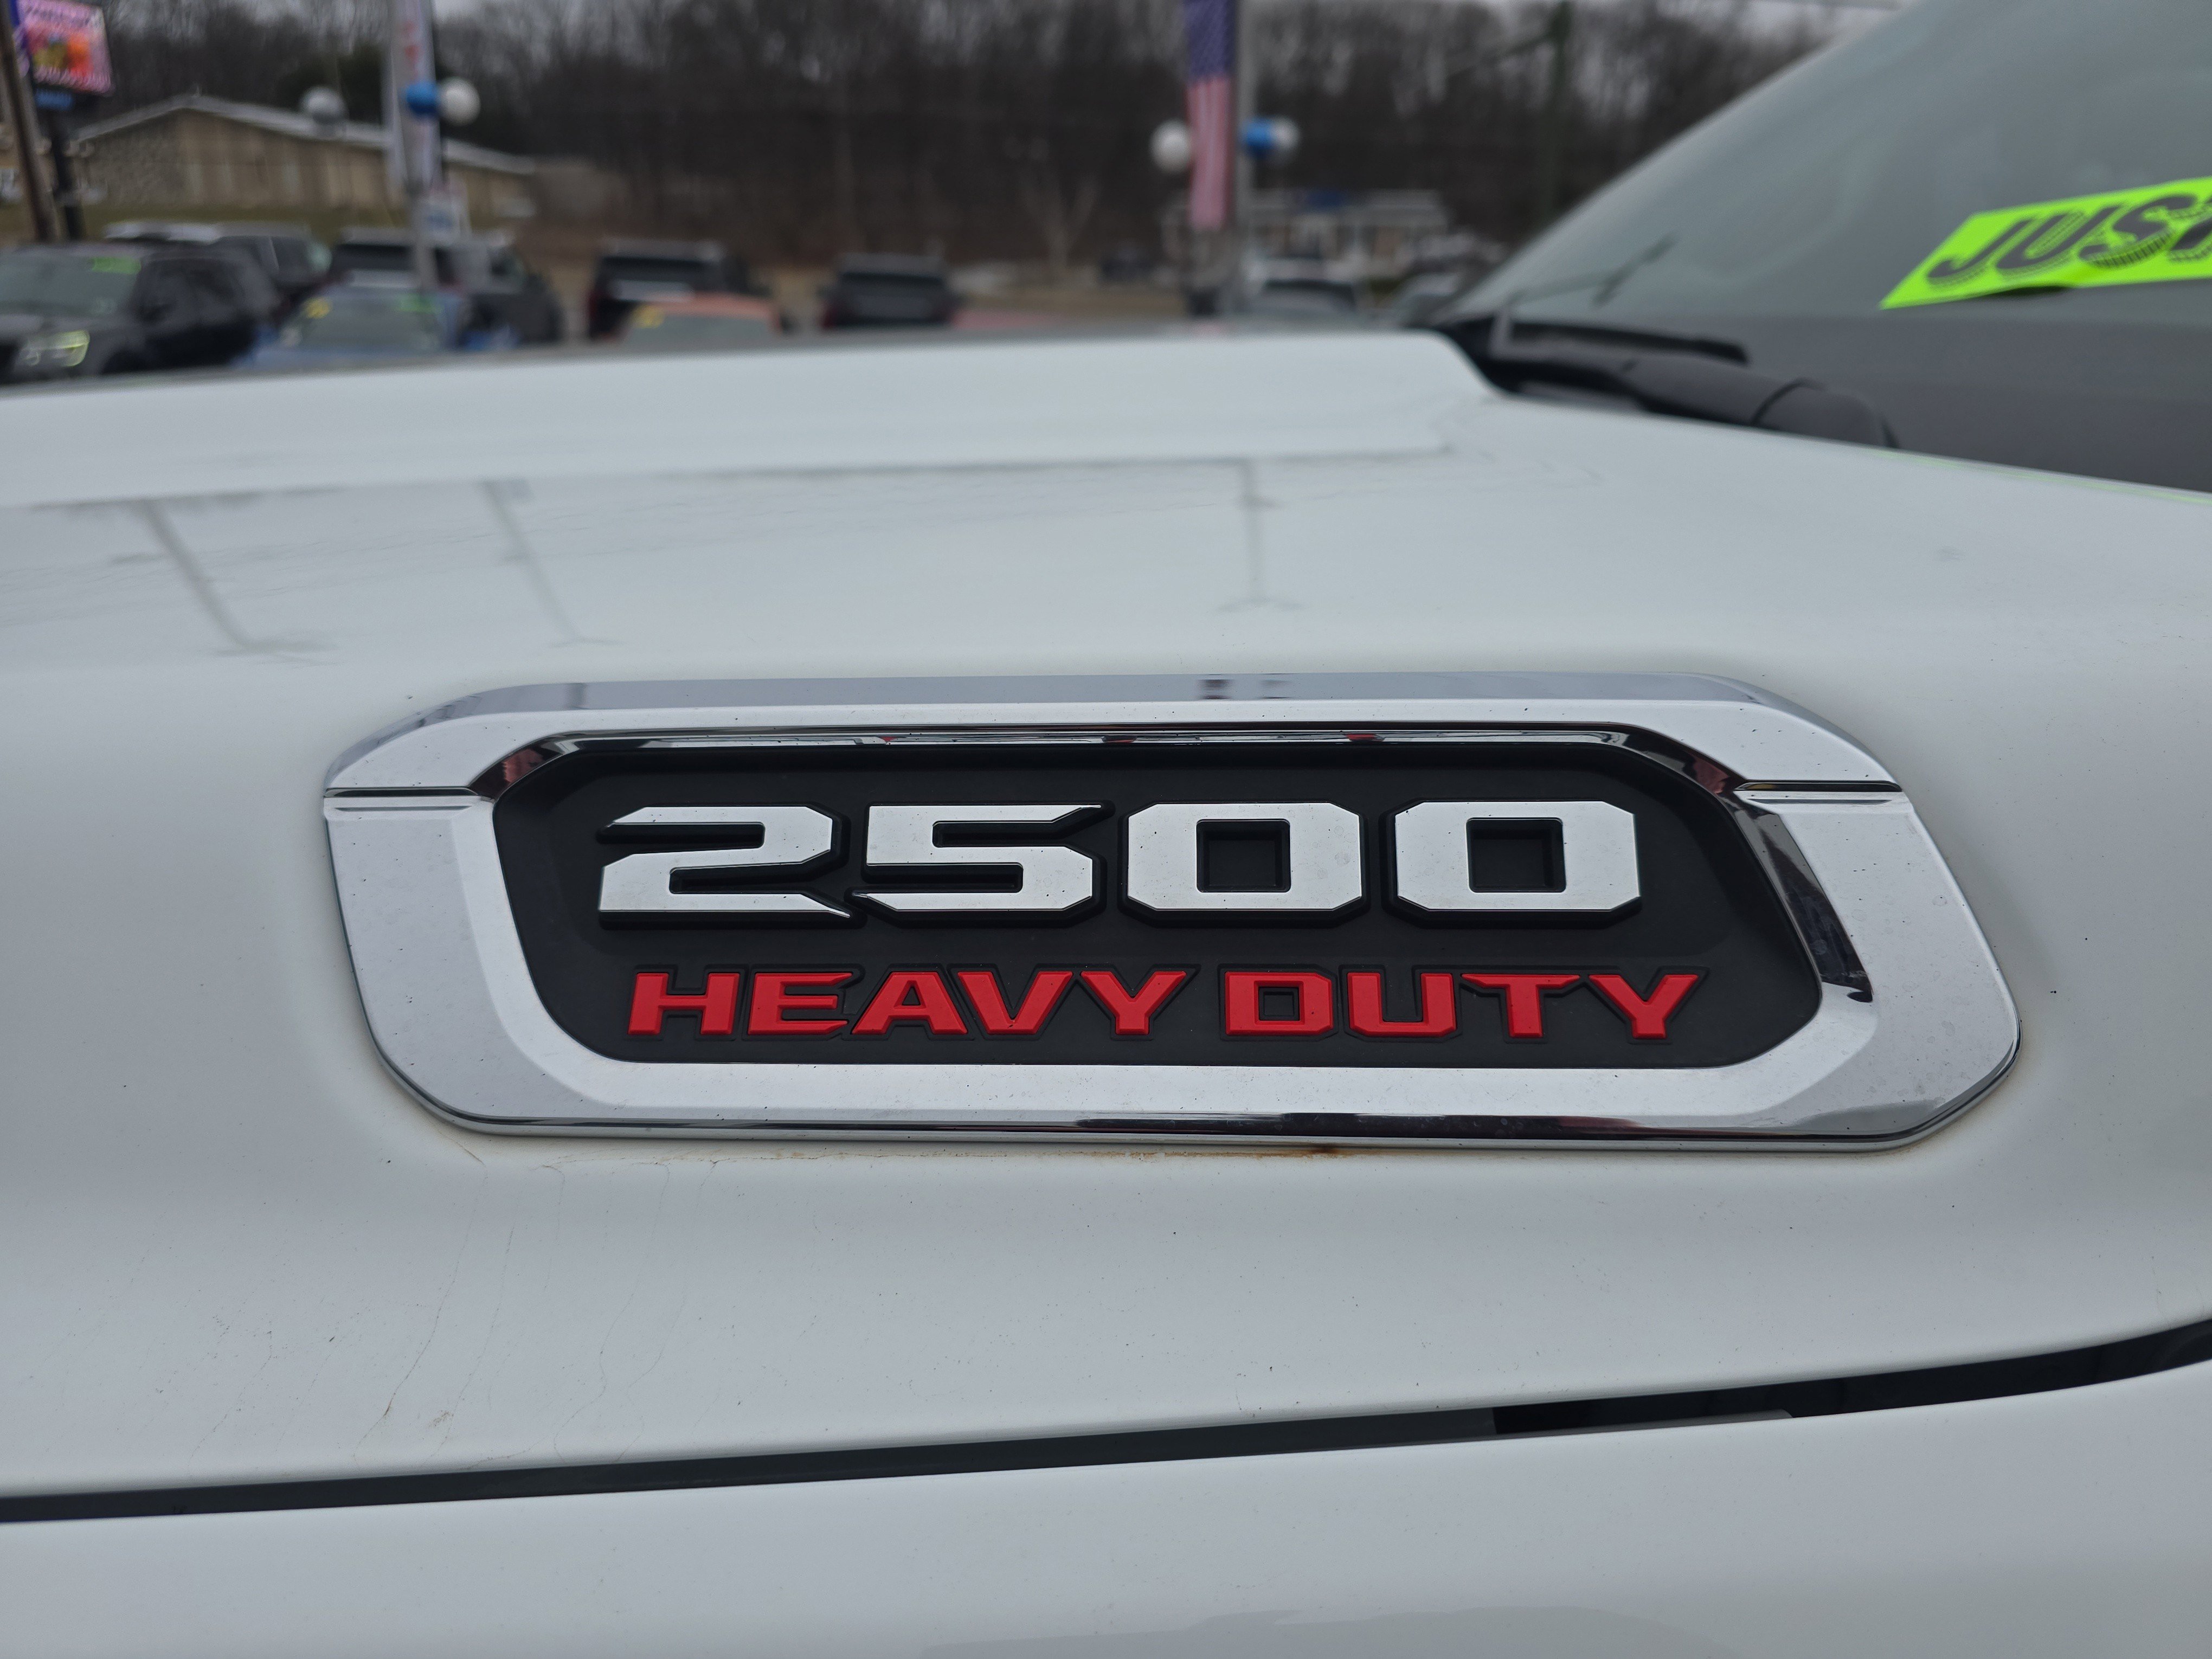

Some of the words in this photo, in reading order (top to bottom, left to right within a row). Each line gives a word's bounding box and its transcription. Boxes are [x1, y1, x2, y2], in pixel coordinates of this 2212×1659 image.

[599, 801, 1641, 918] 2500
[628, 971, 1187, 1035] HEAVY
[1225, 971, 1699, 1038] DUTY
